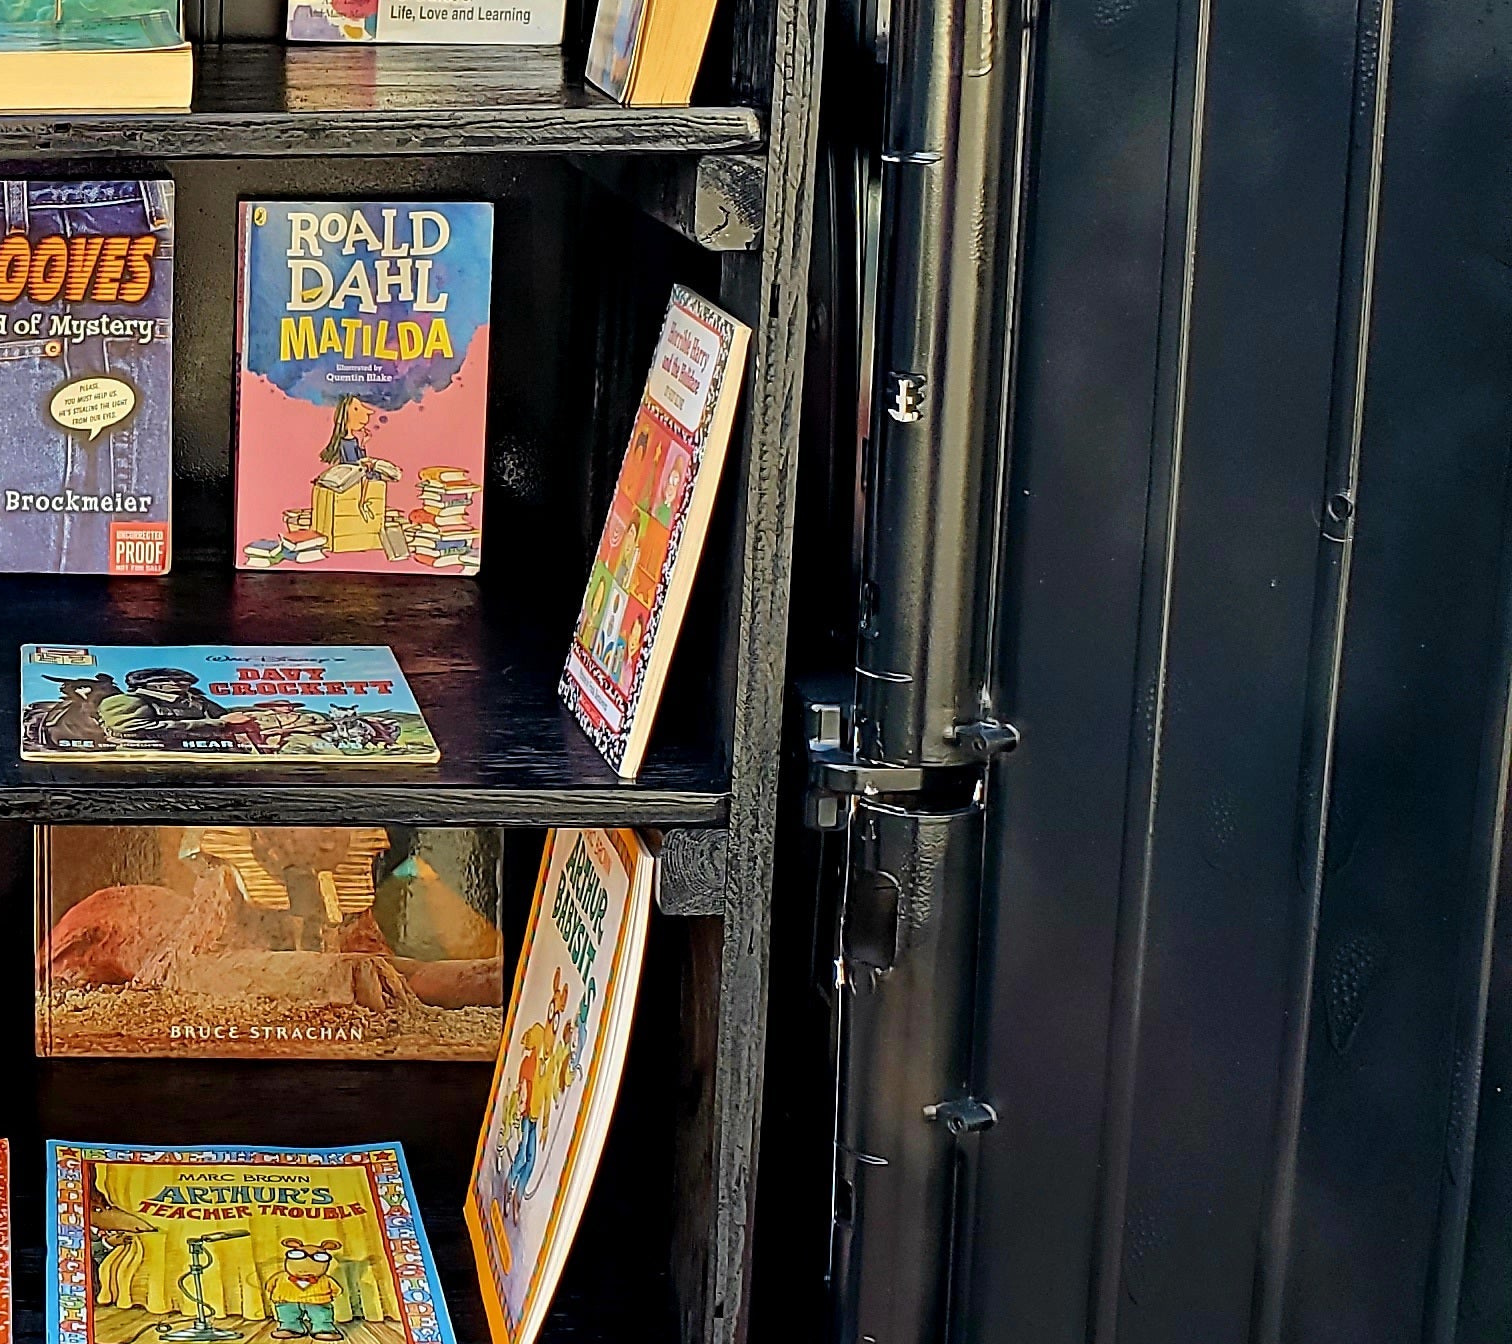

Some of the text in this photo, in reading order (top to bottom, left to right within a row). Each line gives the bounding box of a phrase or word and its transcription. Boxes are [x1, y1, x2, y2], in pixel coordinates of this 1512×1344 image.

[390, 6, 530, 25] Life, Love and Learning
[287, 208, 451, 256] ROALD
[286, 259, 449, 314] DAHL
[14, 313, 42, 335] of
[49, 314, 154, 344] Mystery
[280, 317, 453, 361] MATILDA
[326, 373, 393, 384] Quentin Blake
[5, 489, 152, 513] Brockmeier
[116, 541, 164, 565] PROOF
[236, 667, 326, 681] DAVY
[209, 680, 393, 696] CROCKETT
[58, 739, 94, 748] SEE
[182, 739, 234, 749] HEAR
[566, 831, 608, 945] ARTHUR
[552, 869, 597, 1024] BABYSITS
[170, 1025, 363, 1042] BRUCE STRACHAN
[178, 1173, 311, 1184] MARC BROWN
[155, 1185, 335, 1205] ARTHUR'S
[138, 1201, 368, 1221] TEACHER TROUBLE
